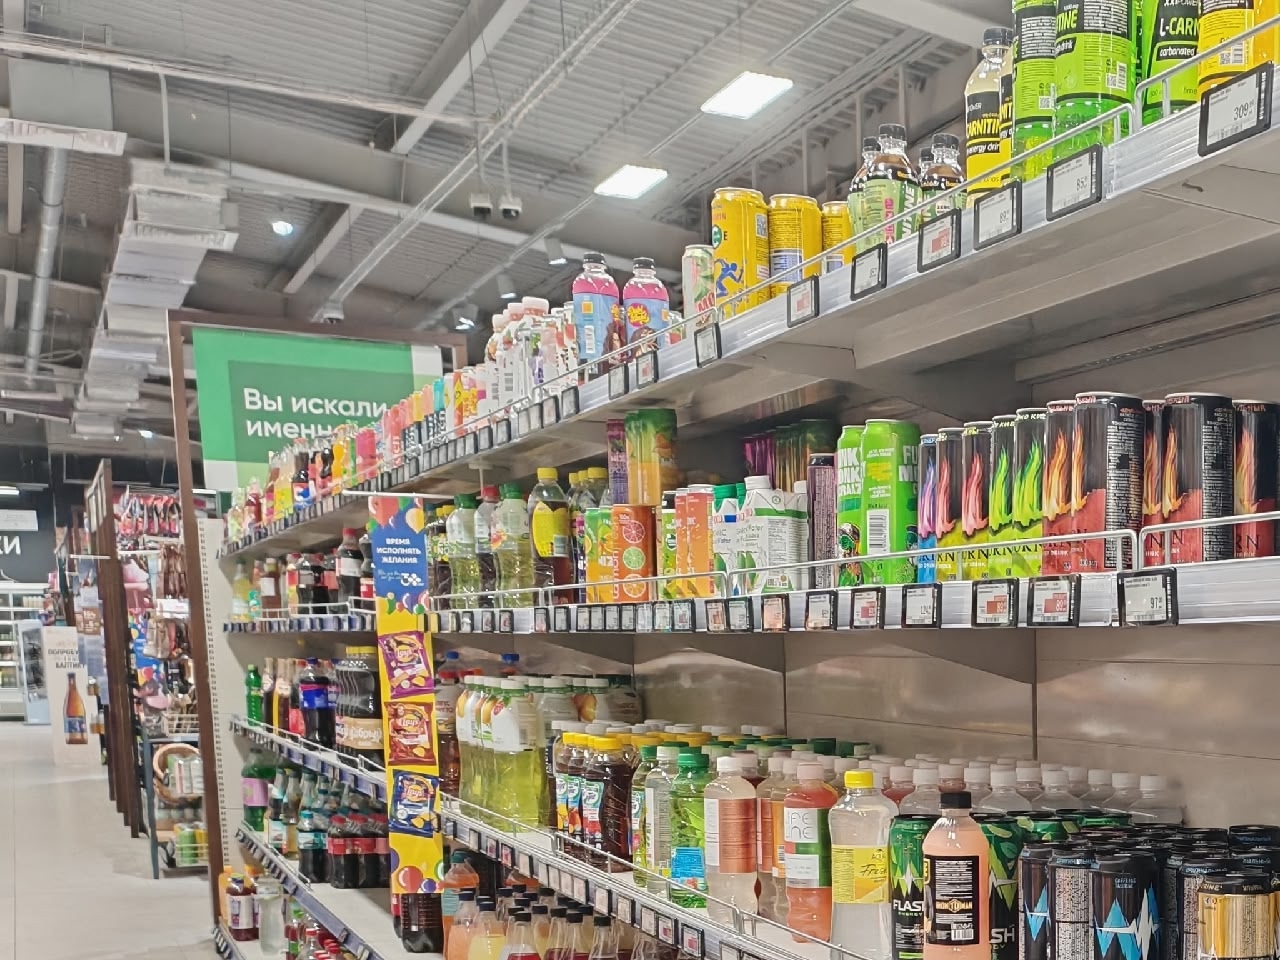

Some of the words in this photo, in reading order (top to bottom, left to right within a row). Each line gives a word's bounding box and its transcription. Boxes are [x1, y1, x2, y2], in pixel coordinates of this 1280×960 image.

[1233, 103, 1249, 121] 309
[243, 388, 282, 412] Вы
[292, 396, 387, 418] искали
[376, 547, 421, 555] ИСПОЛНЯТЬ
[381, 556, 418, 564] ЖЕЛАНИЯ
